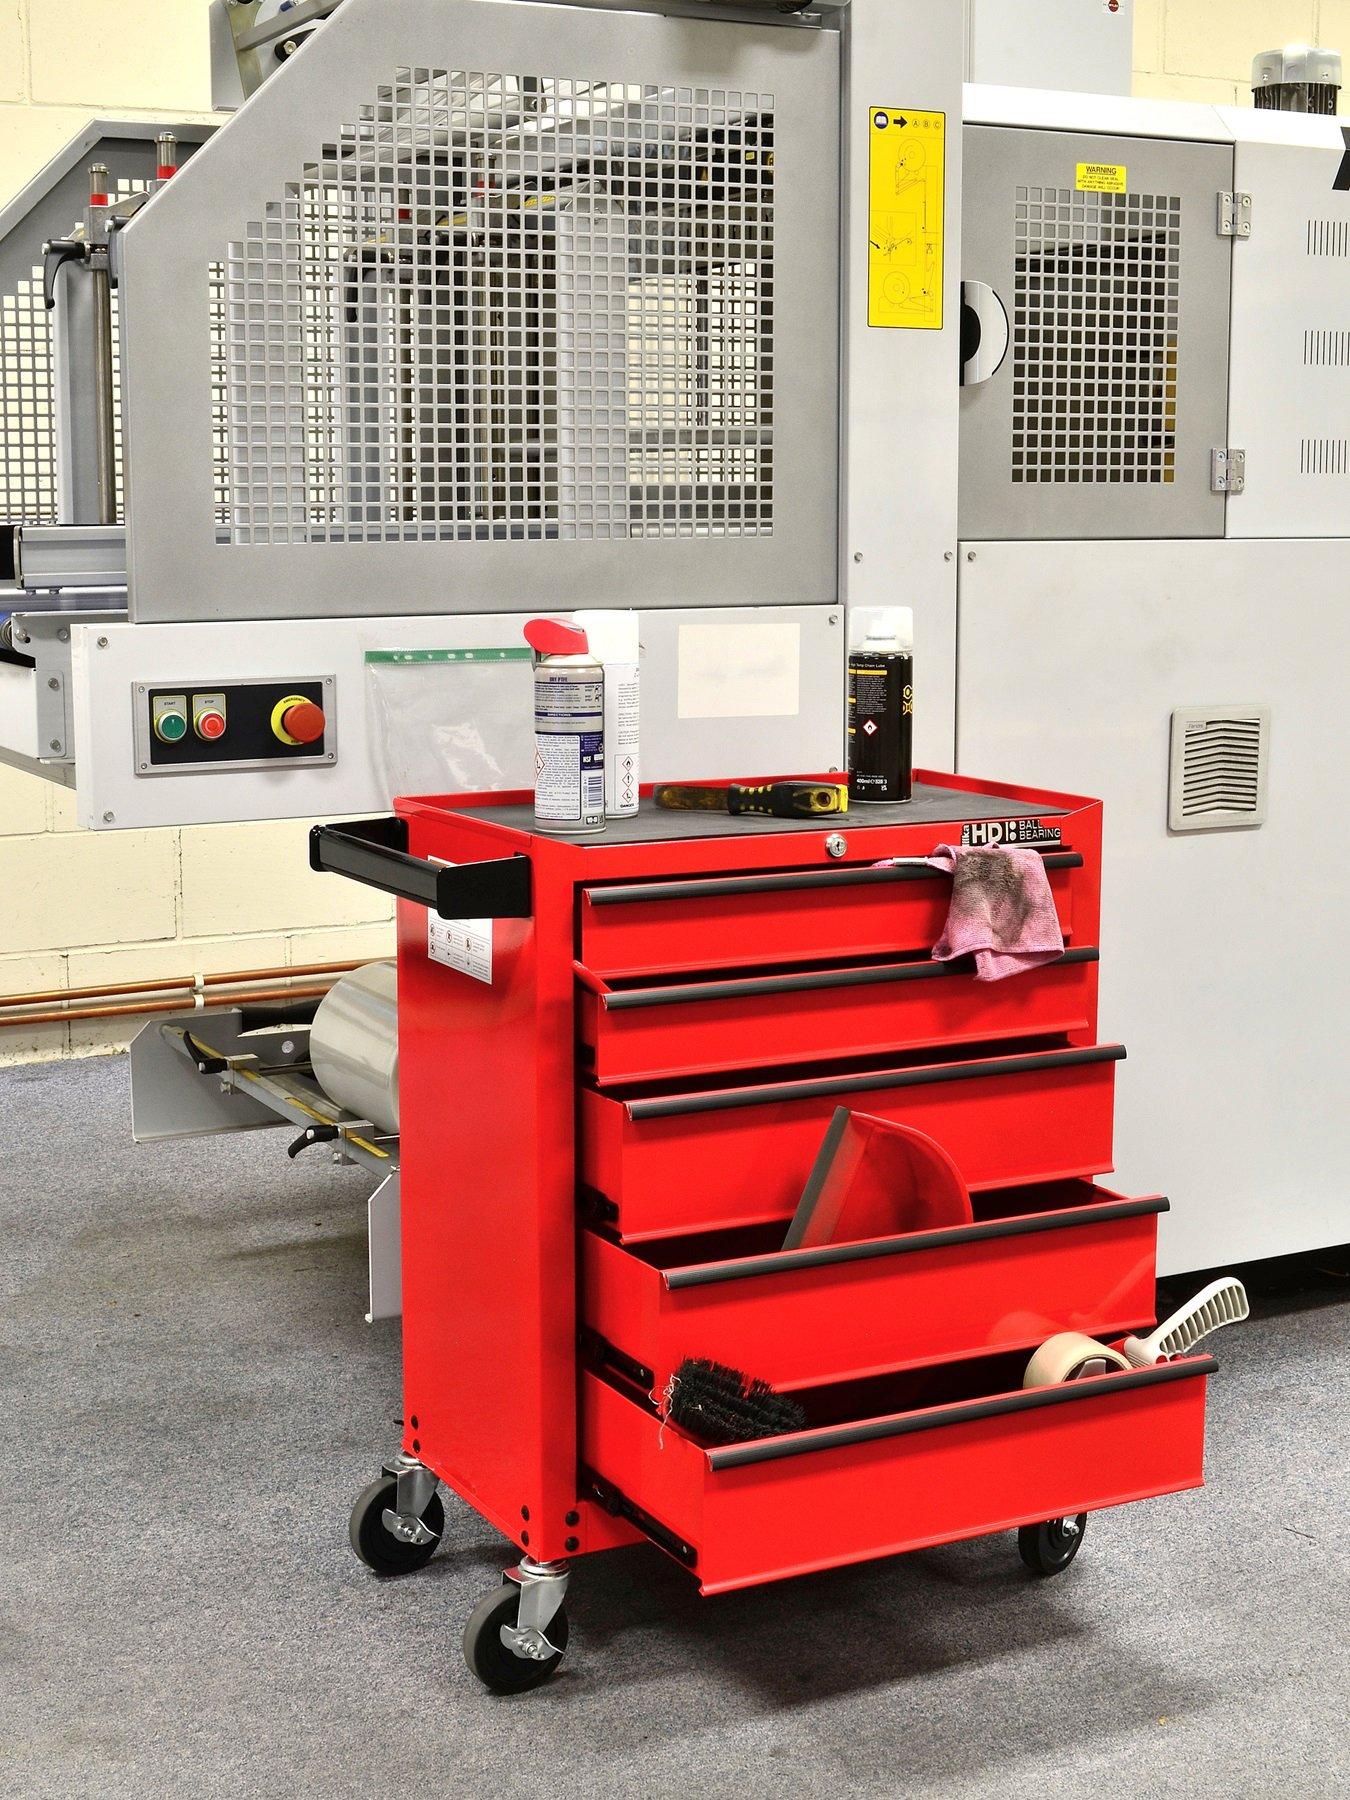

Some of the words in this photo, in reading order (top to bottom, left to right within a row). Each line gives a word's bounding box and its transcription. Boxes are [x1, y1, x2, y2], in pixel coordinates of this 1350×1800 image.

[1086, 166, 1116, 174] WARNING
[1019, 820, 1043, 830] BALL
[1019, 828, 1060, 840] BEARING
